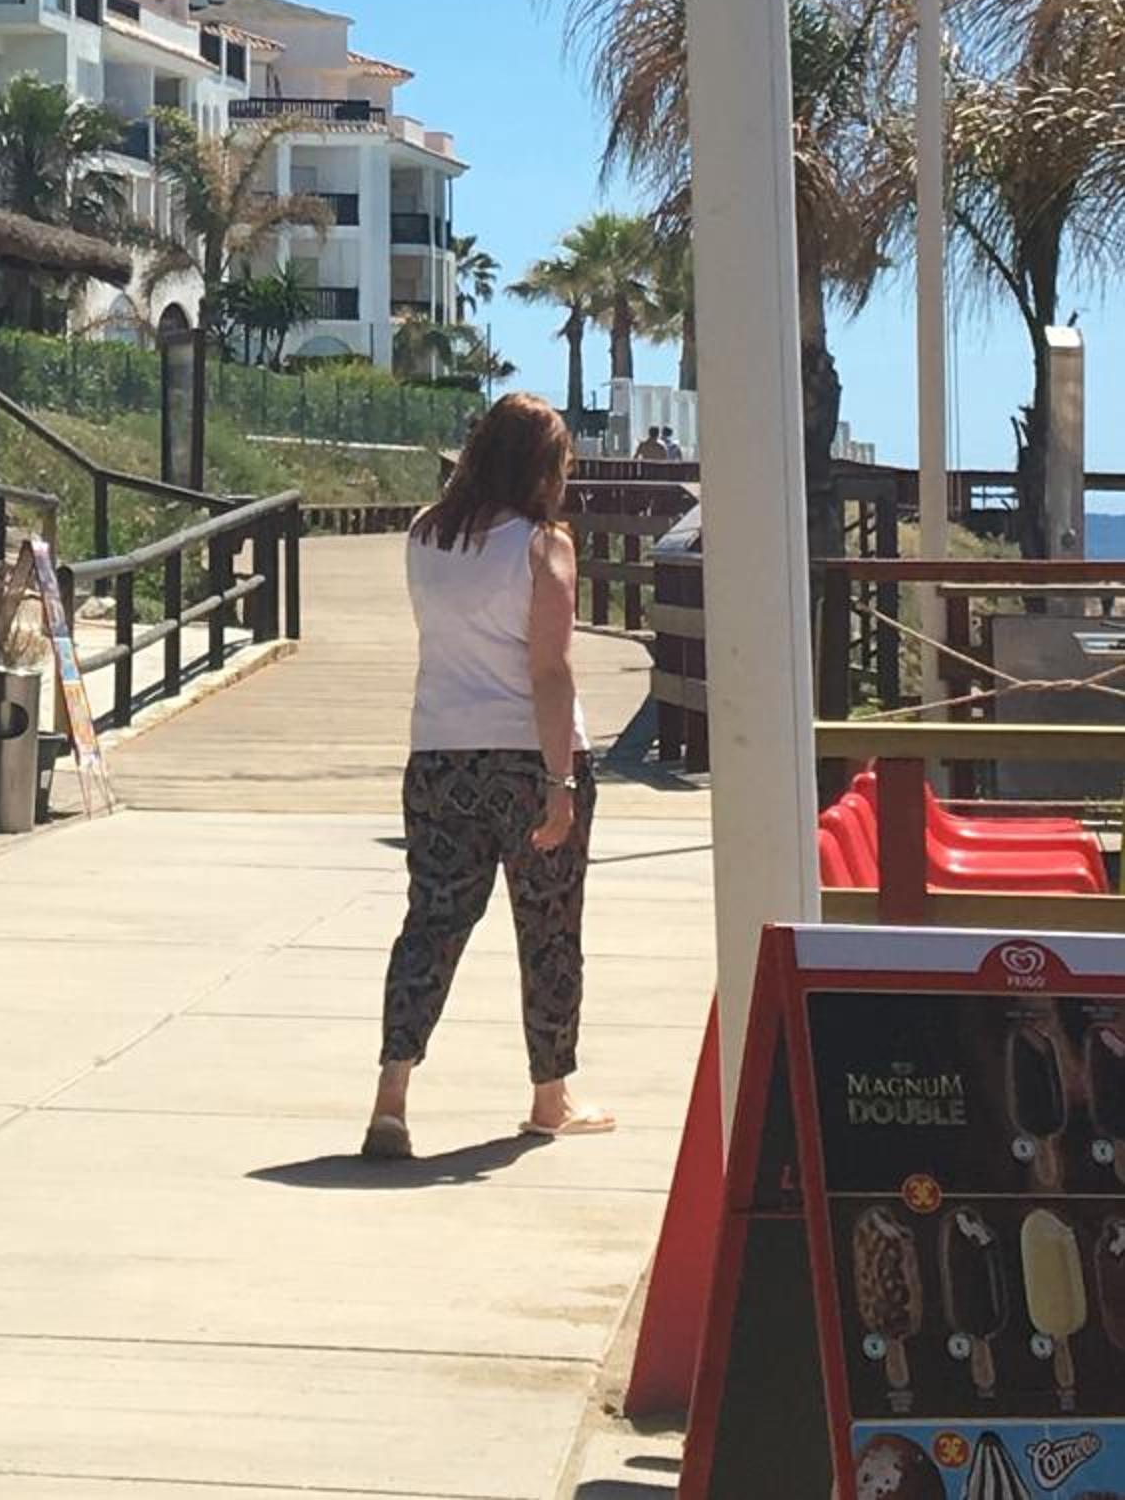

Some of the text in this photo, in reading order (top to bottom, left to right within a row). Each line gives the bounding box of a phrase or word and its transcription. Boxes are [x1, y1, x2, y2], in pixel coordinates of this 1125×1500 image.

[845, 1073, 965, 1097] MAGNUM
[847, 1099, 967, 1125] DOUBLE
[937, 1432, 964, 1464] 3€
